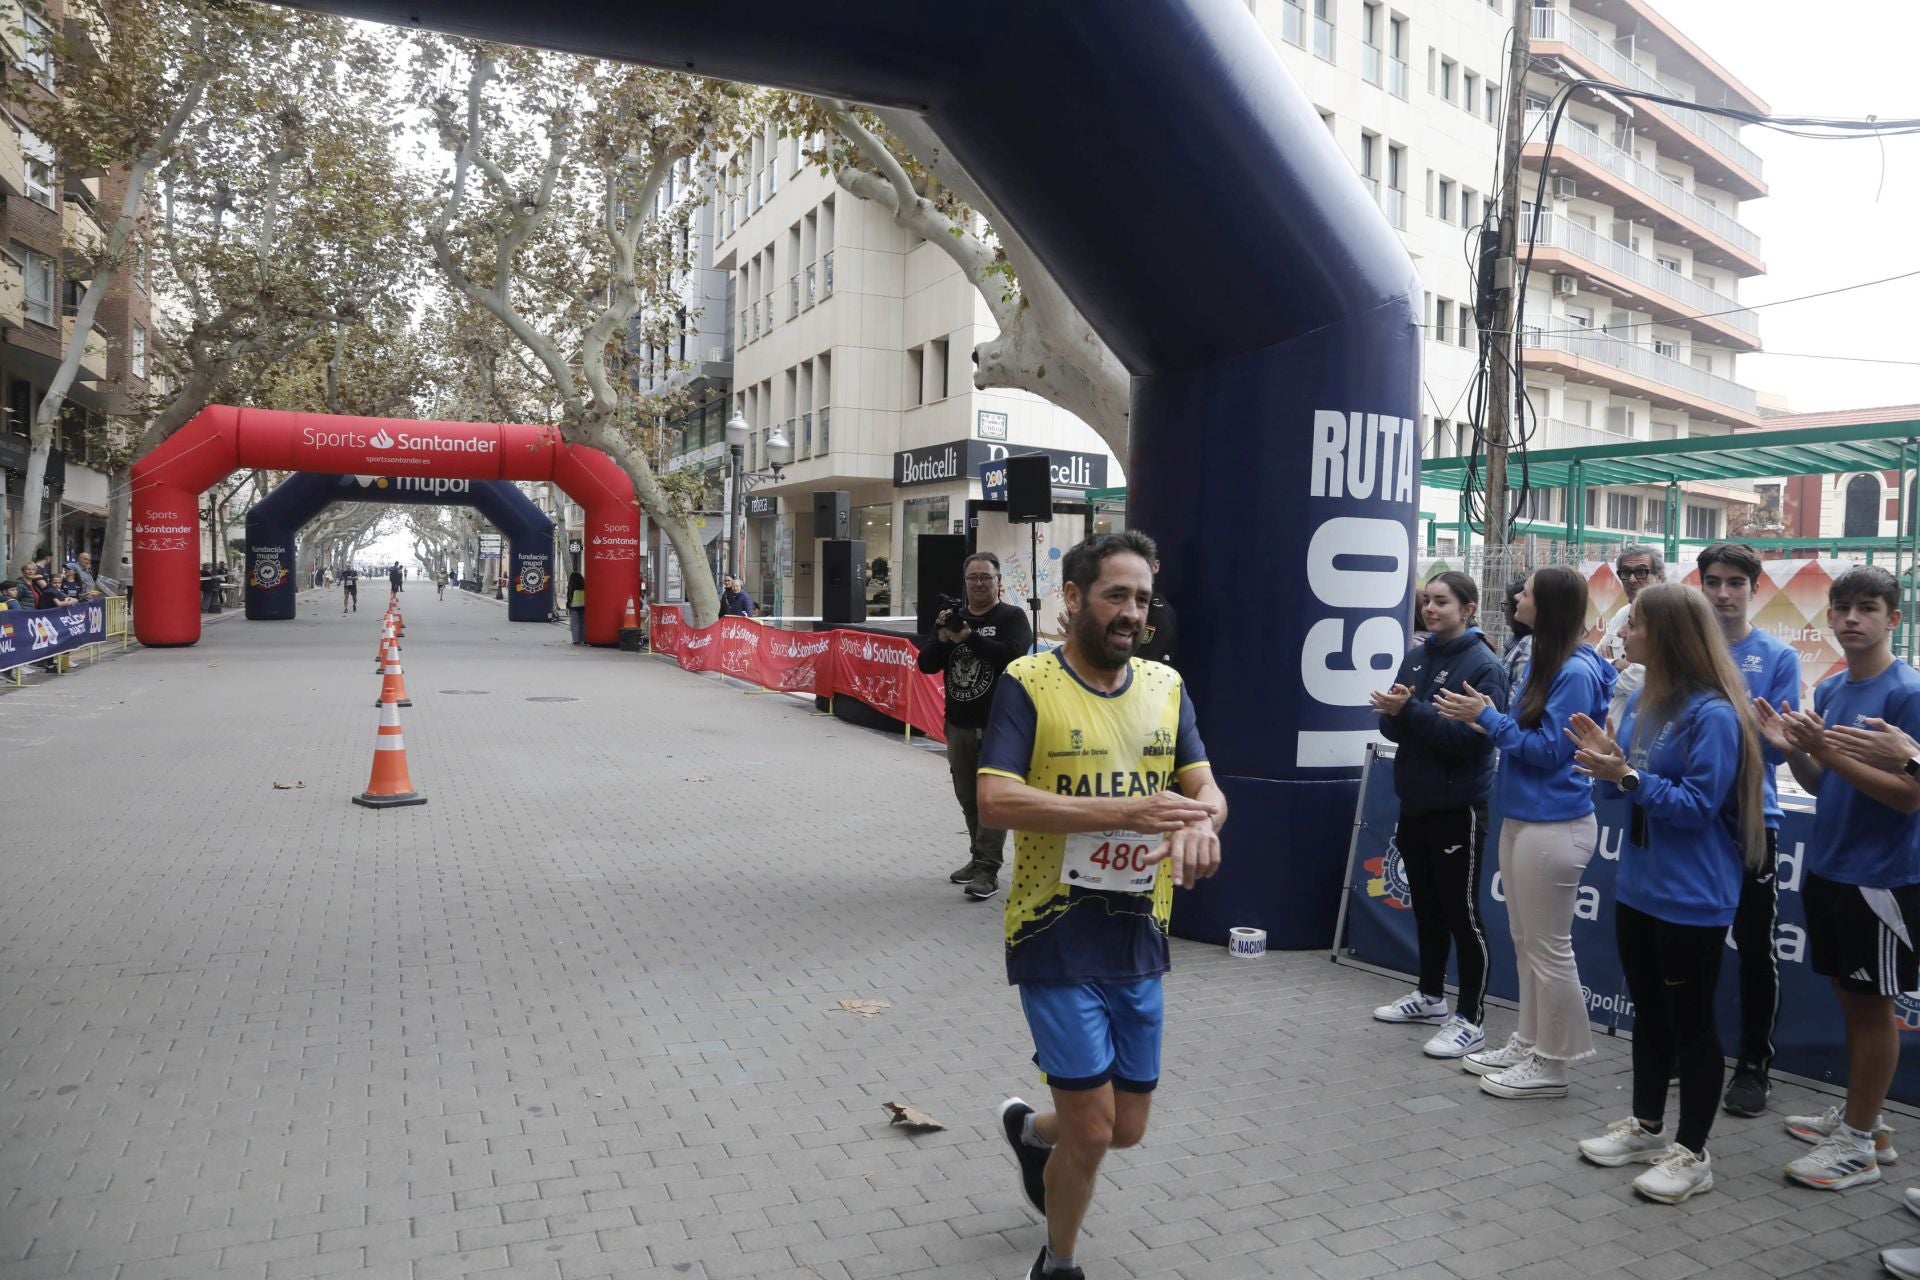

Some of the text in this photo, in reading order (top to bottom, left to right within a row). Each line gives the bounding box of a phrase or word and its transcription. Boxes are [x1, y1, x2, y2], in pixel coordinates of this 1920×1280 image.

[303, 427, 497, 453] Sports Santander
[366, 455, 432, 465] sportssantander.es
[1310, 409, 1415, 504] RUTA
[901, 446, 957, 484] Botticelli
[146, 509, 178, 521] Sports
[144, 525, 192, 534] Santander
[604, 523, 630, 533] Sports
[256, 552, 279, 561] mupol
[518, 552, 549, 561] fundación
[522, 560, 543, 568] mupol
